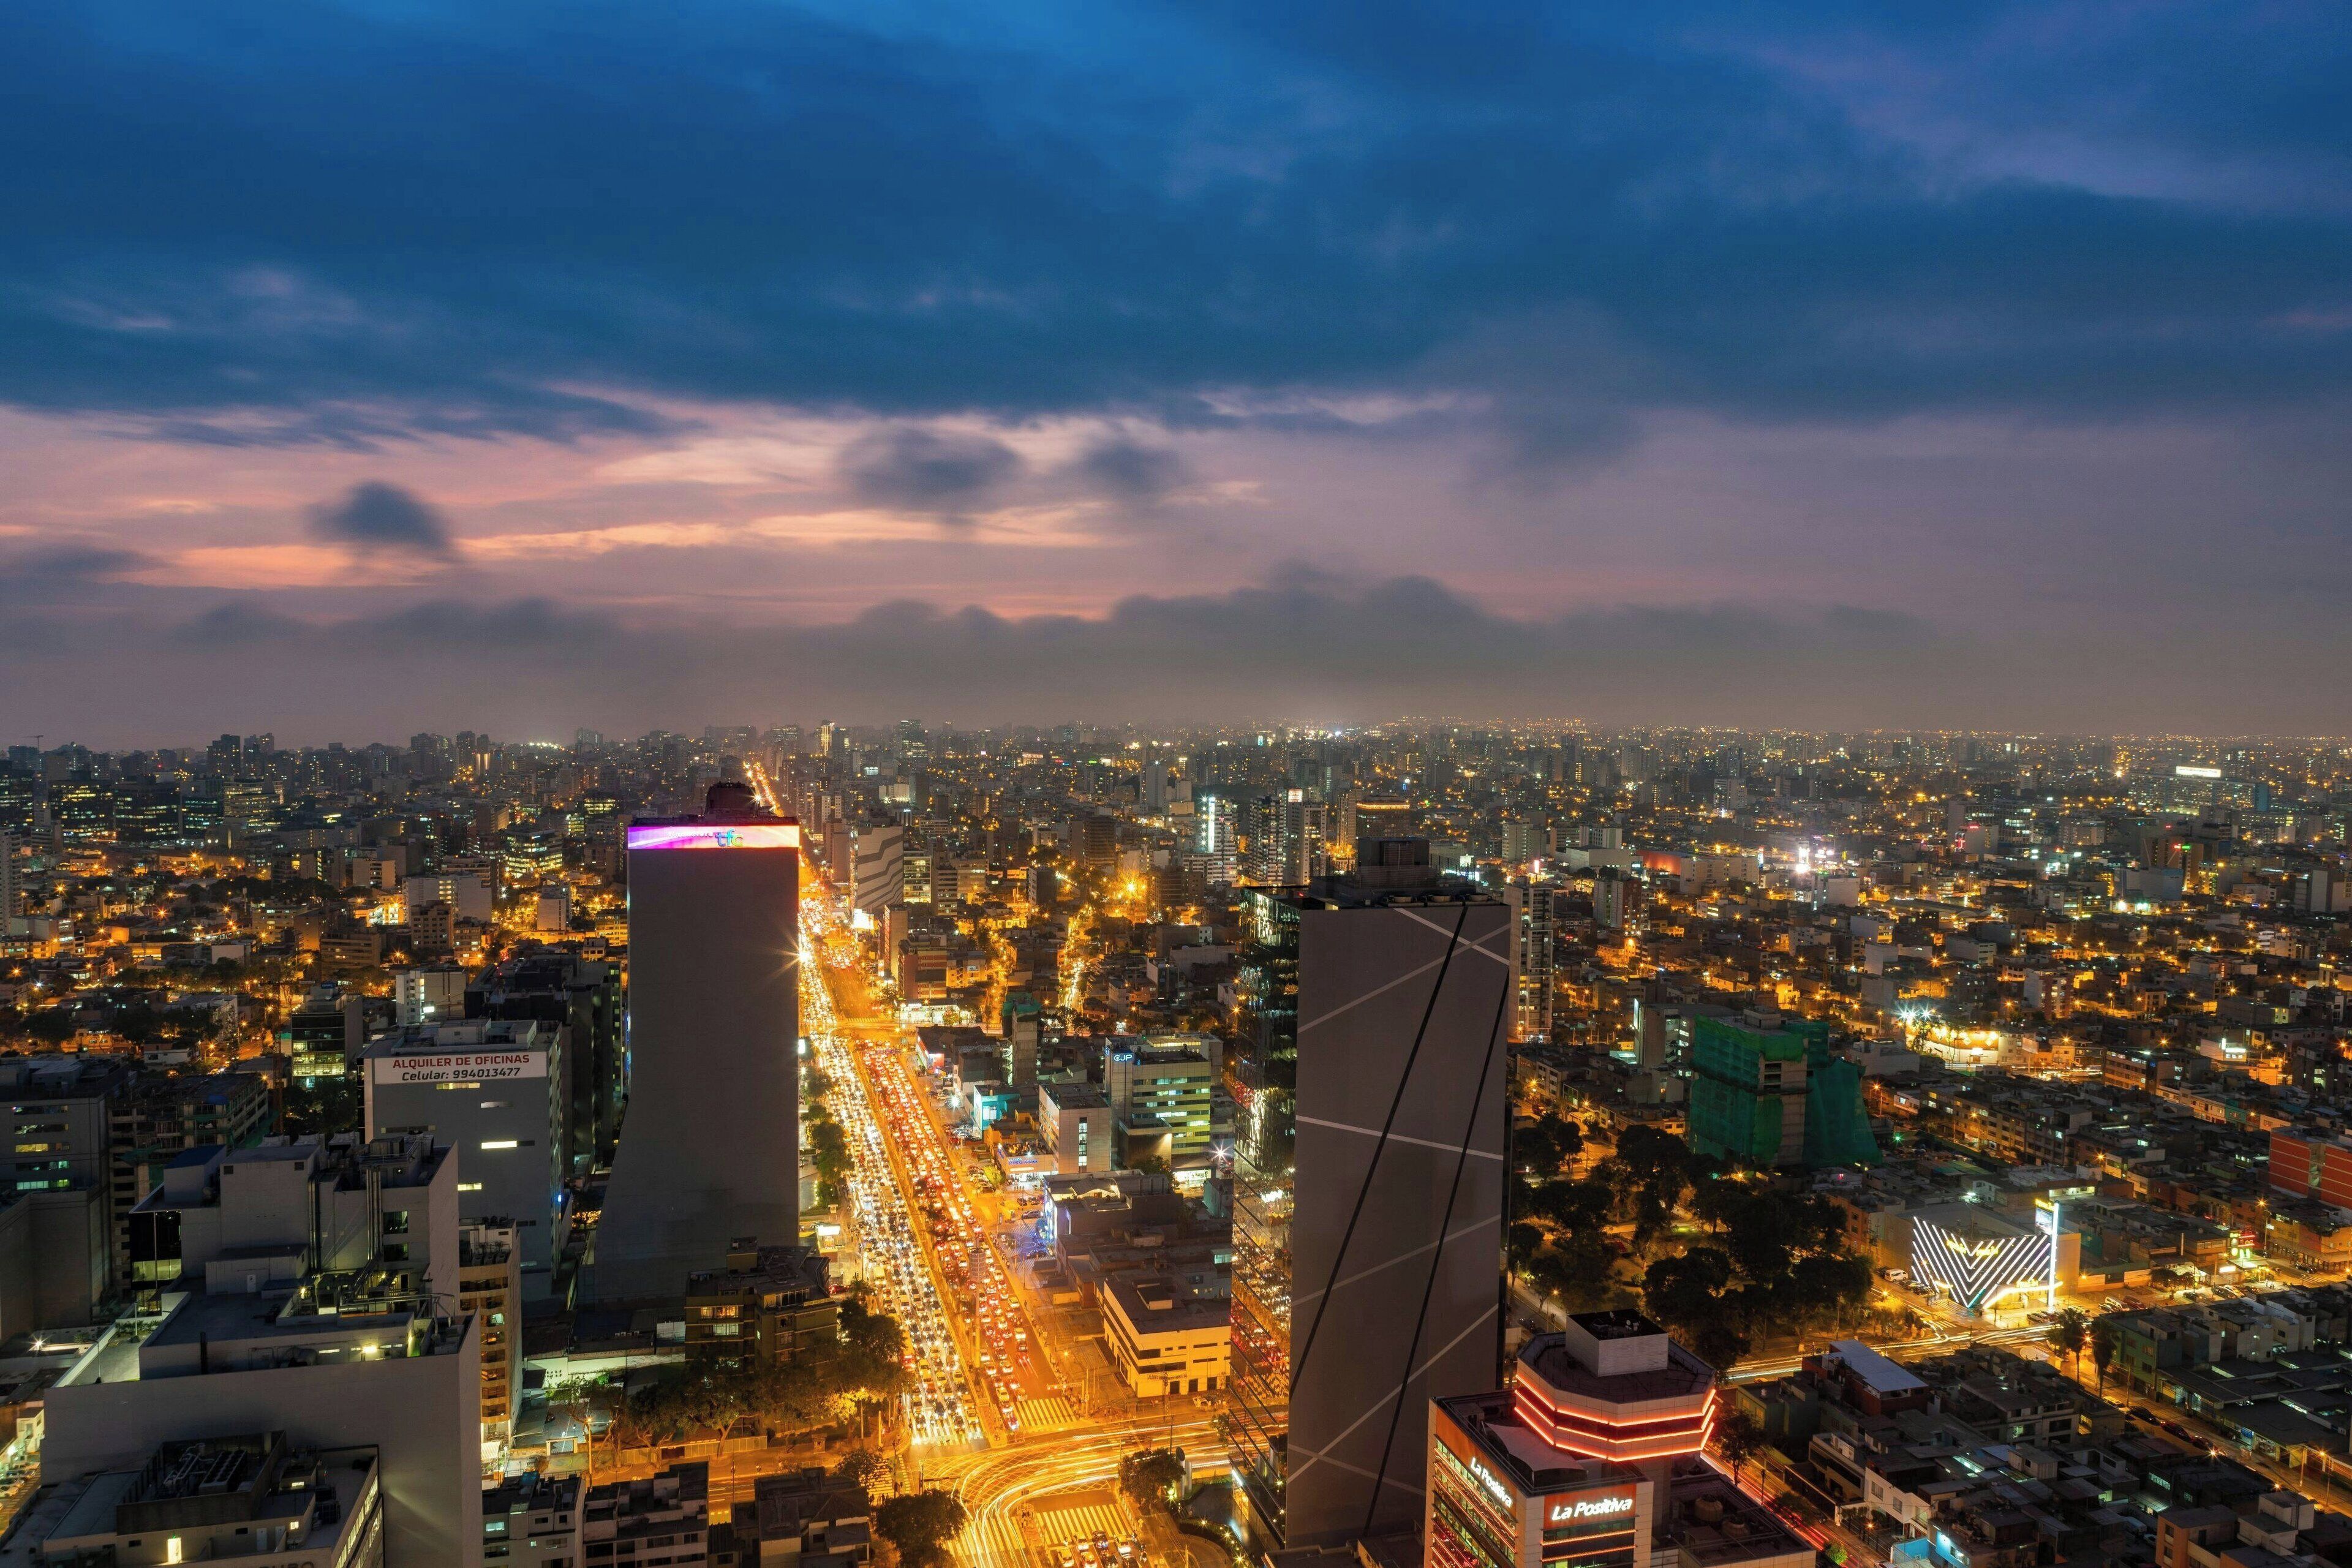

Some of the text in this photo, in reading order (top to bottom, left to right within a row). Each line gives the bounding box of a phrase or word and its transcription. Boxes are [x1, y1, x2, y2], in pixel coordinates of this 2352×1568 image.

[715, 827, 744, 846] tfc
[393, 1054, 530, 1069] ALQUILER DE OFICINAS
[402, 1067, 521, 1081] Celular: 994013477
[1471, 1457, 1512, 1508] La Positiva
[1551, 1498, 1633, 1520] La Positiva
